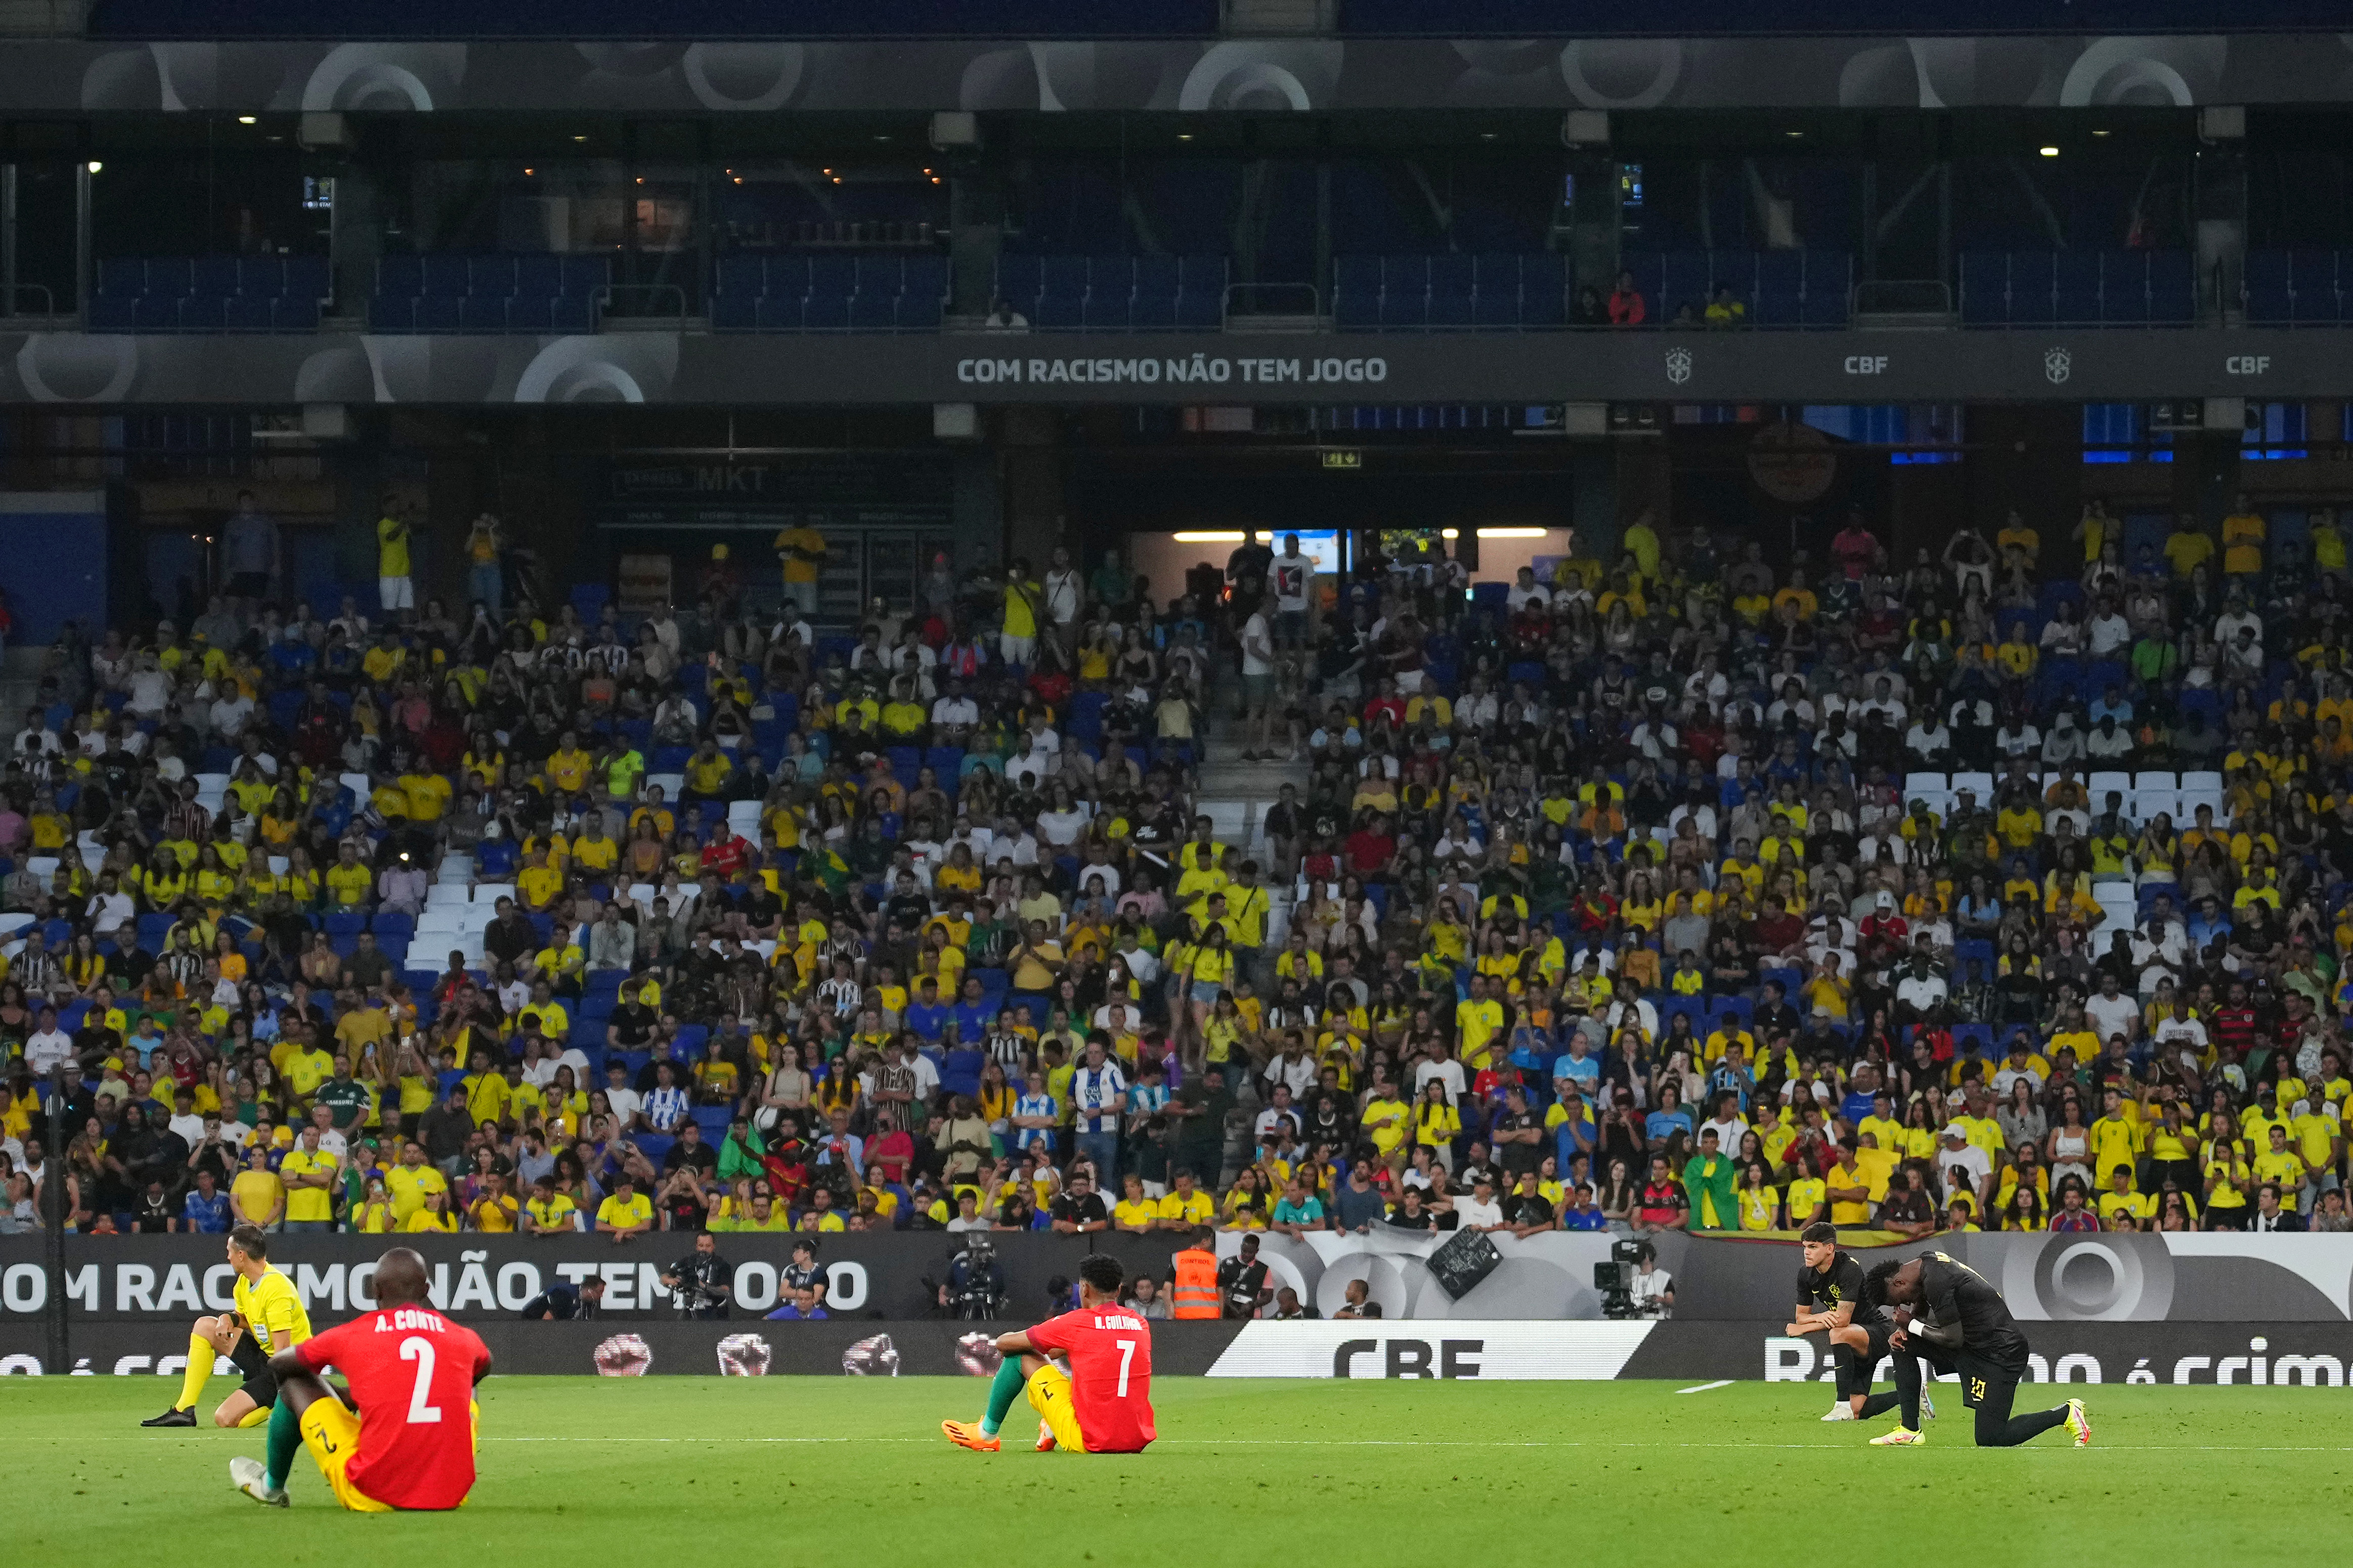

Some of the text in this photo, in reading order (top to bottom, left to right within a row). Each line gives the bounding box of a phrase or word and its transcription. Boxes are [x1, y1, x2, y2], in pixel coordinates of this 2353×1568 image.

[958, 352, 1386, 382] COM RACISMO NÃO TEM JOGO
[1845, 356, 1887, 374] CBF
[2227, 356, 2270, 374] CBF
[699, 467, 768, 491] MKT
[0, 1263, 99, 1312] OM
[116, 1263, 378, 1312] RACMO
[734, 1262, 867, 1310] OO
[375, 1309, 446, 1333] A. CONTE
[1116, 1339, 1137, 1398] 7
[2173, 1336, 2353, 1387] crim
[399, 1335, 443, 1423] 2
[1971, 1376, 1987, 1400] 10
[316, 1427, 337, 1454] 2
